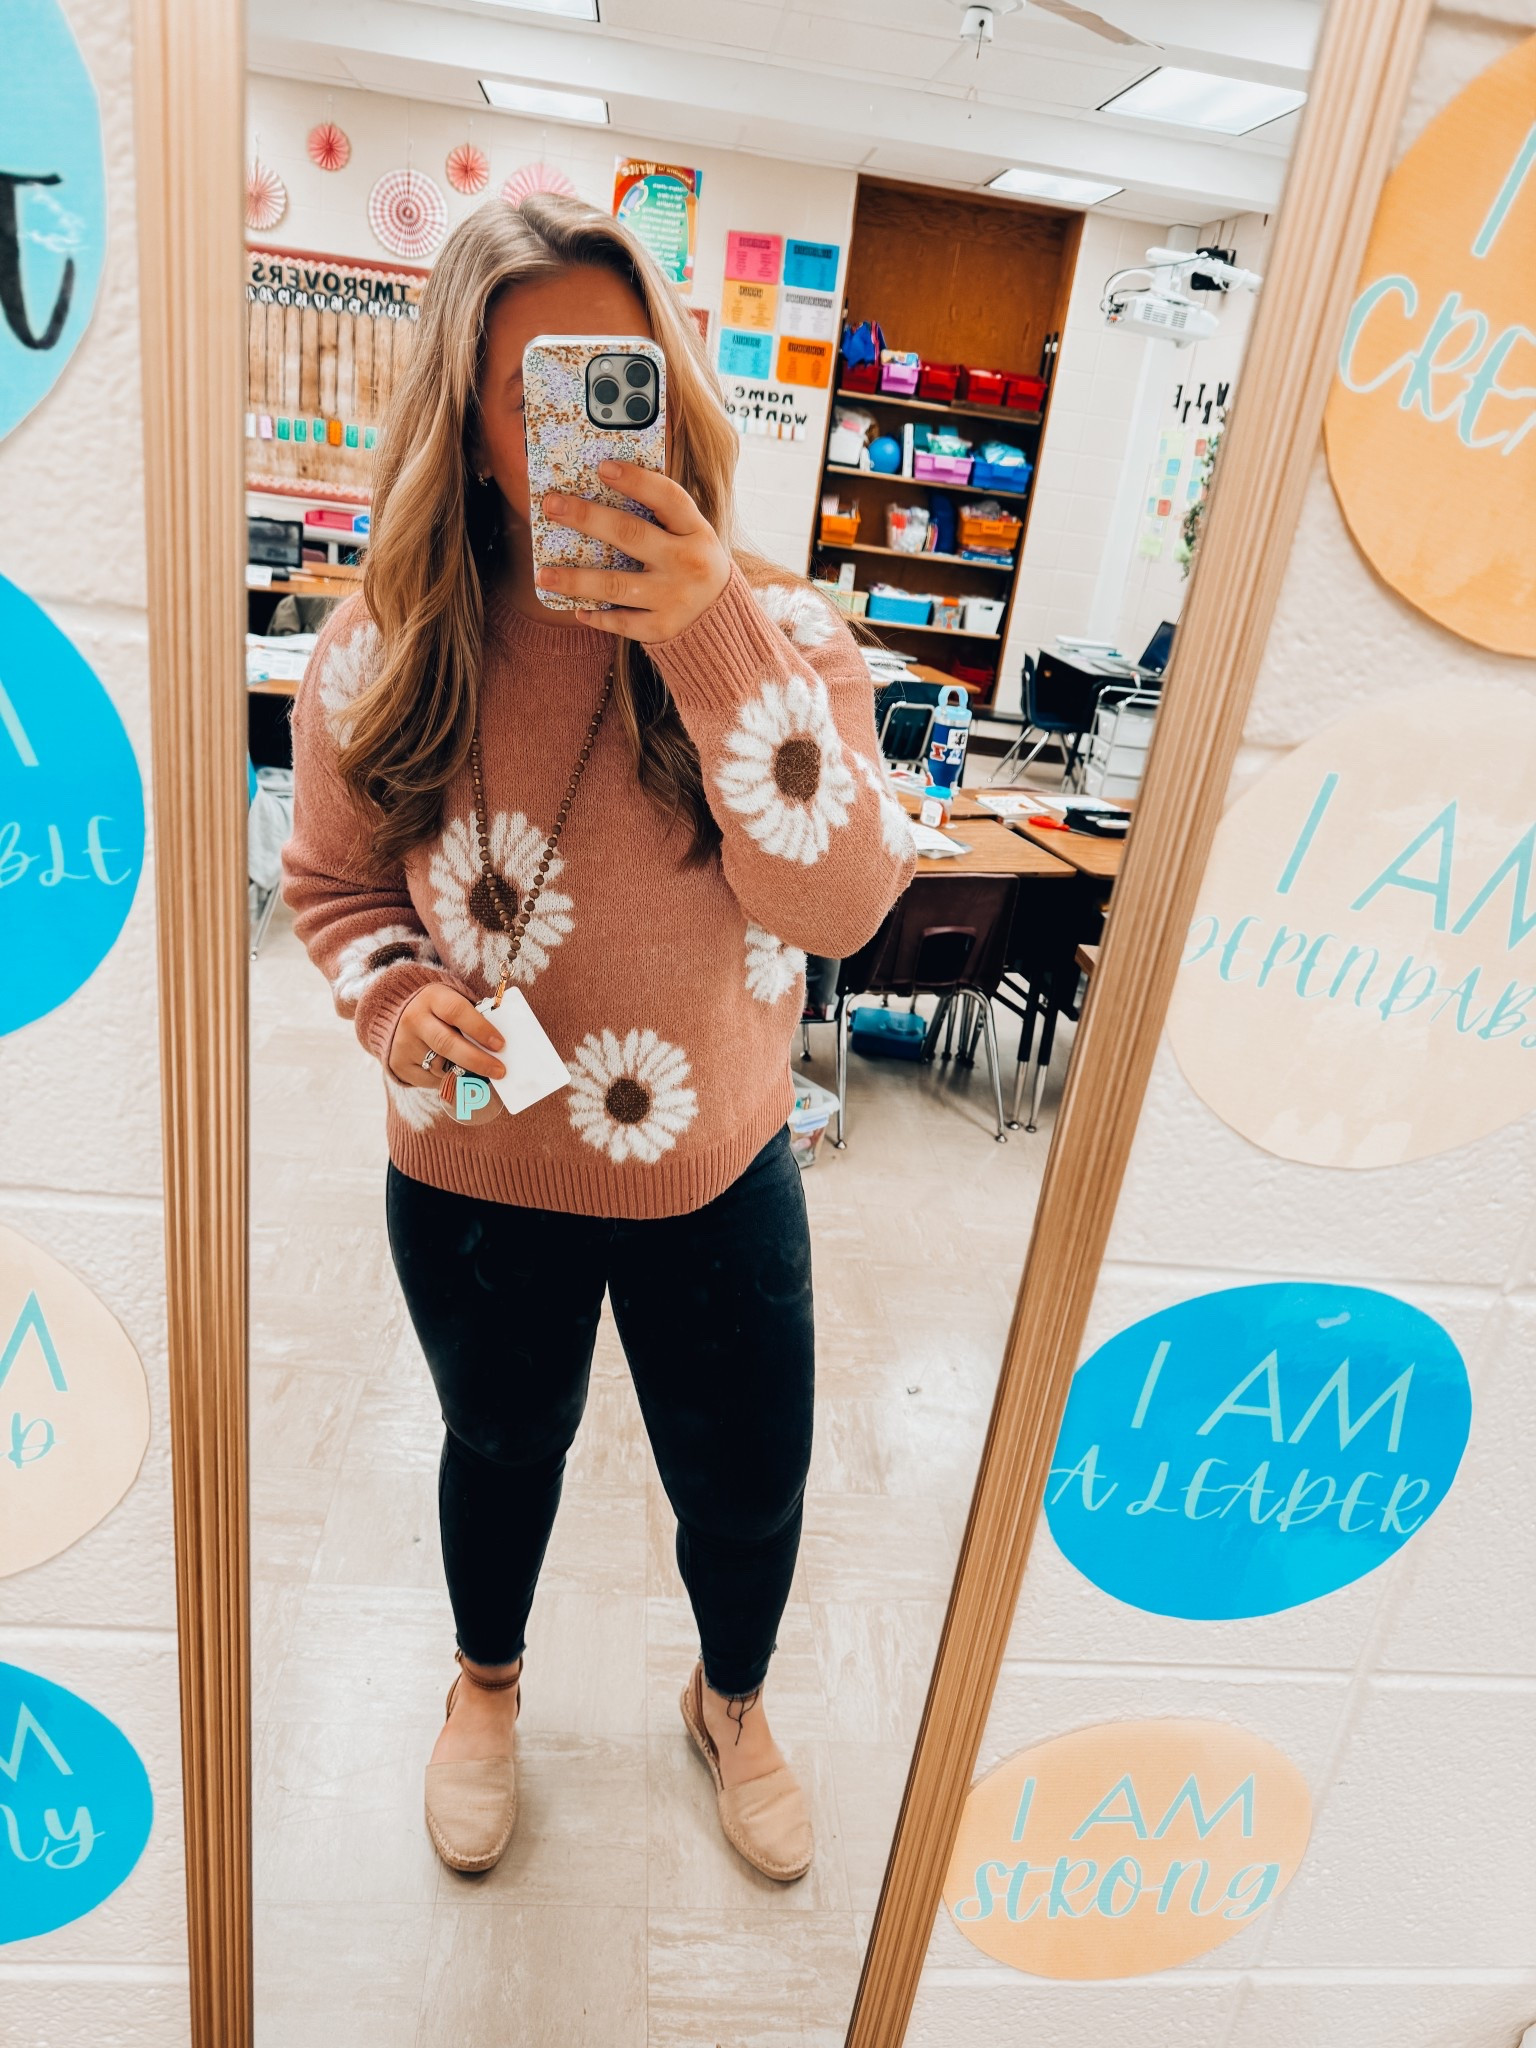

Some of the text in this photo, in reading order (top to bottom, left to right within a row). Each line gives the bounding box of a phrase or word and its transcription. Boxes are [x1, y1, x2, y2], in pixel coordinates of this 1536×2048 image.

[1276, 771, 1340, 894] I
[1182, 914, 1536, 1049] DEPENDAB
[456, 1076, 491, 1121] P
[1130, 1340, 1416, 1453] I AM
[1050, 1444, 1431, 1533] A LEADER
[1011, 1772, 1256, 1843] I AM
